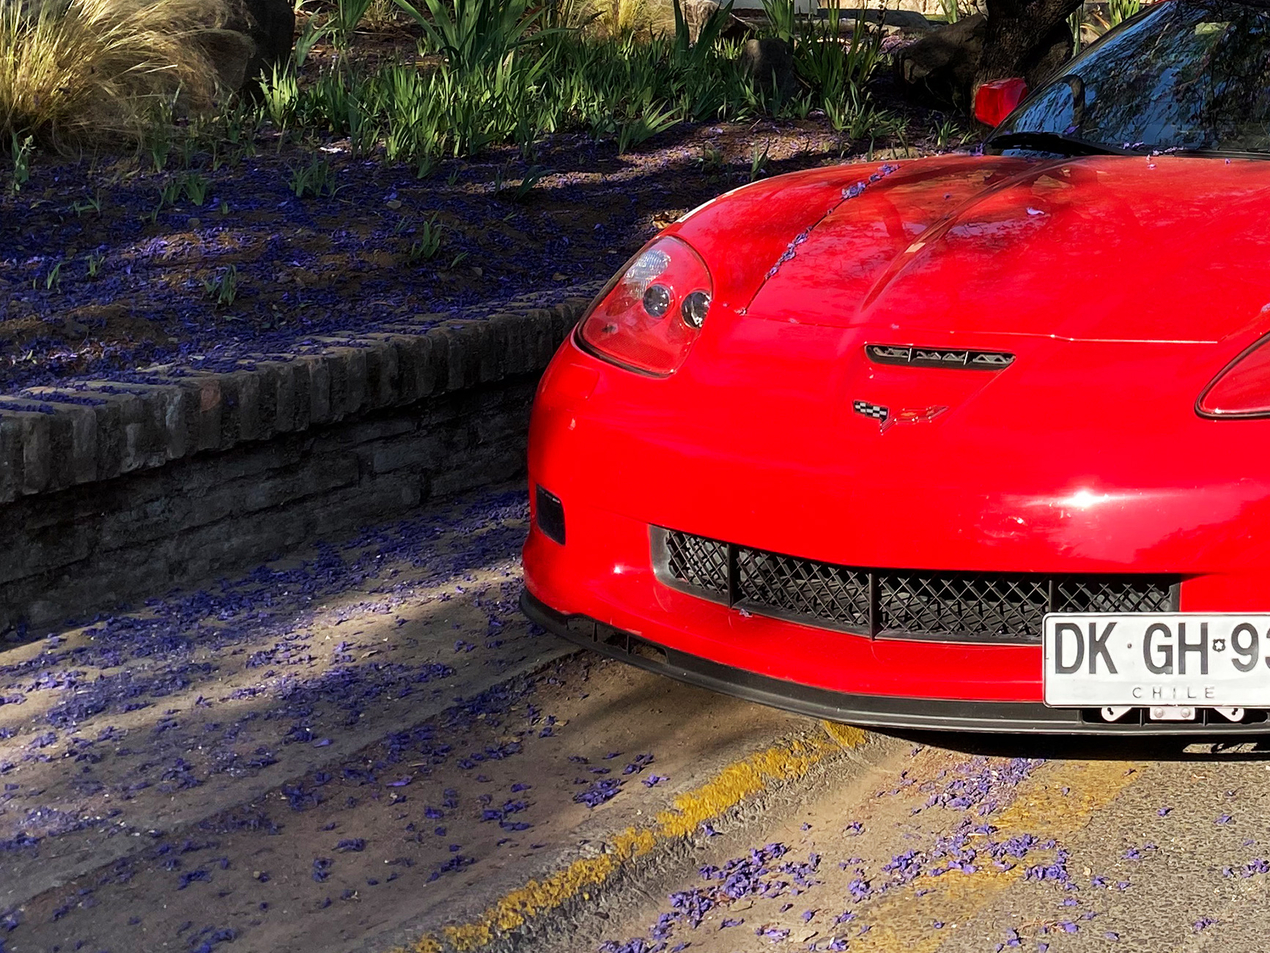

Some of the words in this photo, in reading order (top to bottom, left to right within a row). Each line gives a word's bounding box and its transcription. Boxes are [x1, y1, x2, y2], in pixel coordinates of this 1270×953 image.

[1054, 622, 1118, 675] DK
[1142, 622, 1209, 675] GH
[1132, 686, 1216, 699] CHILE
